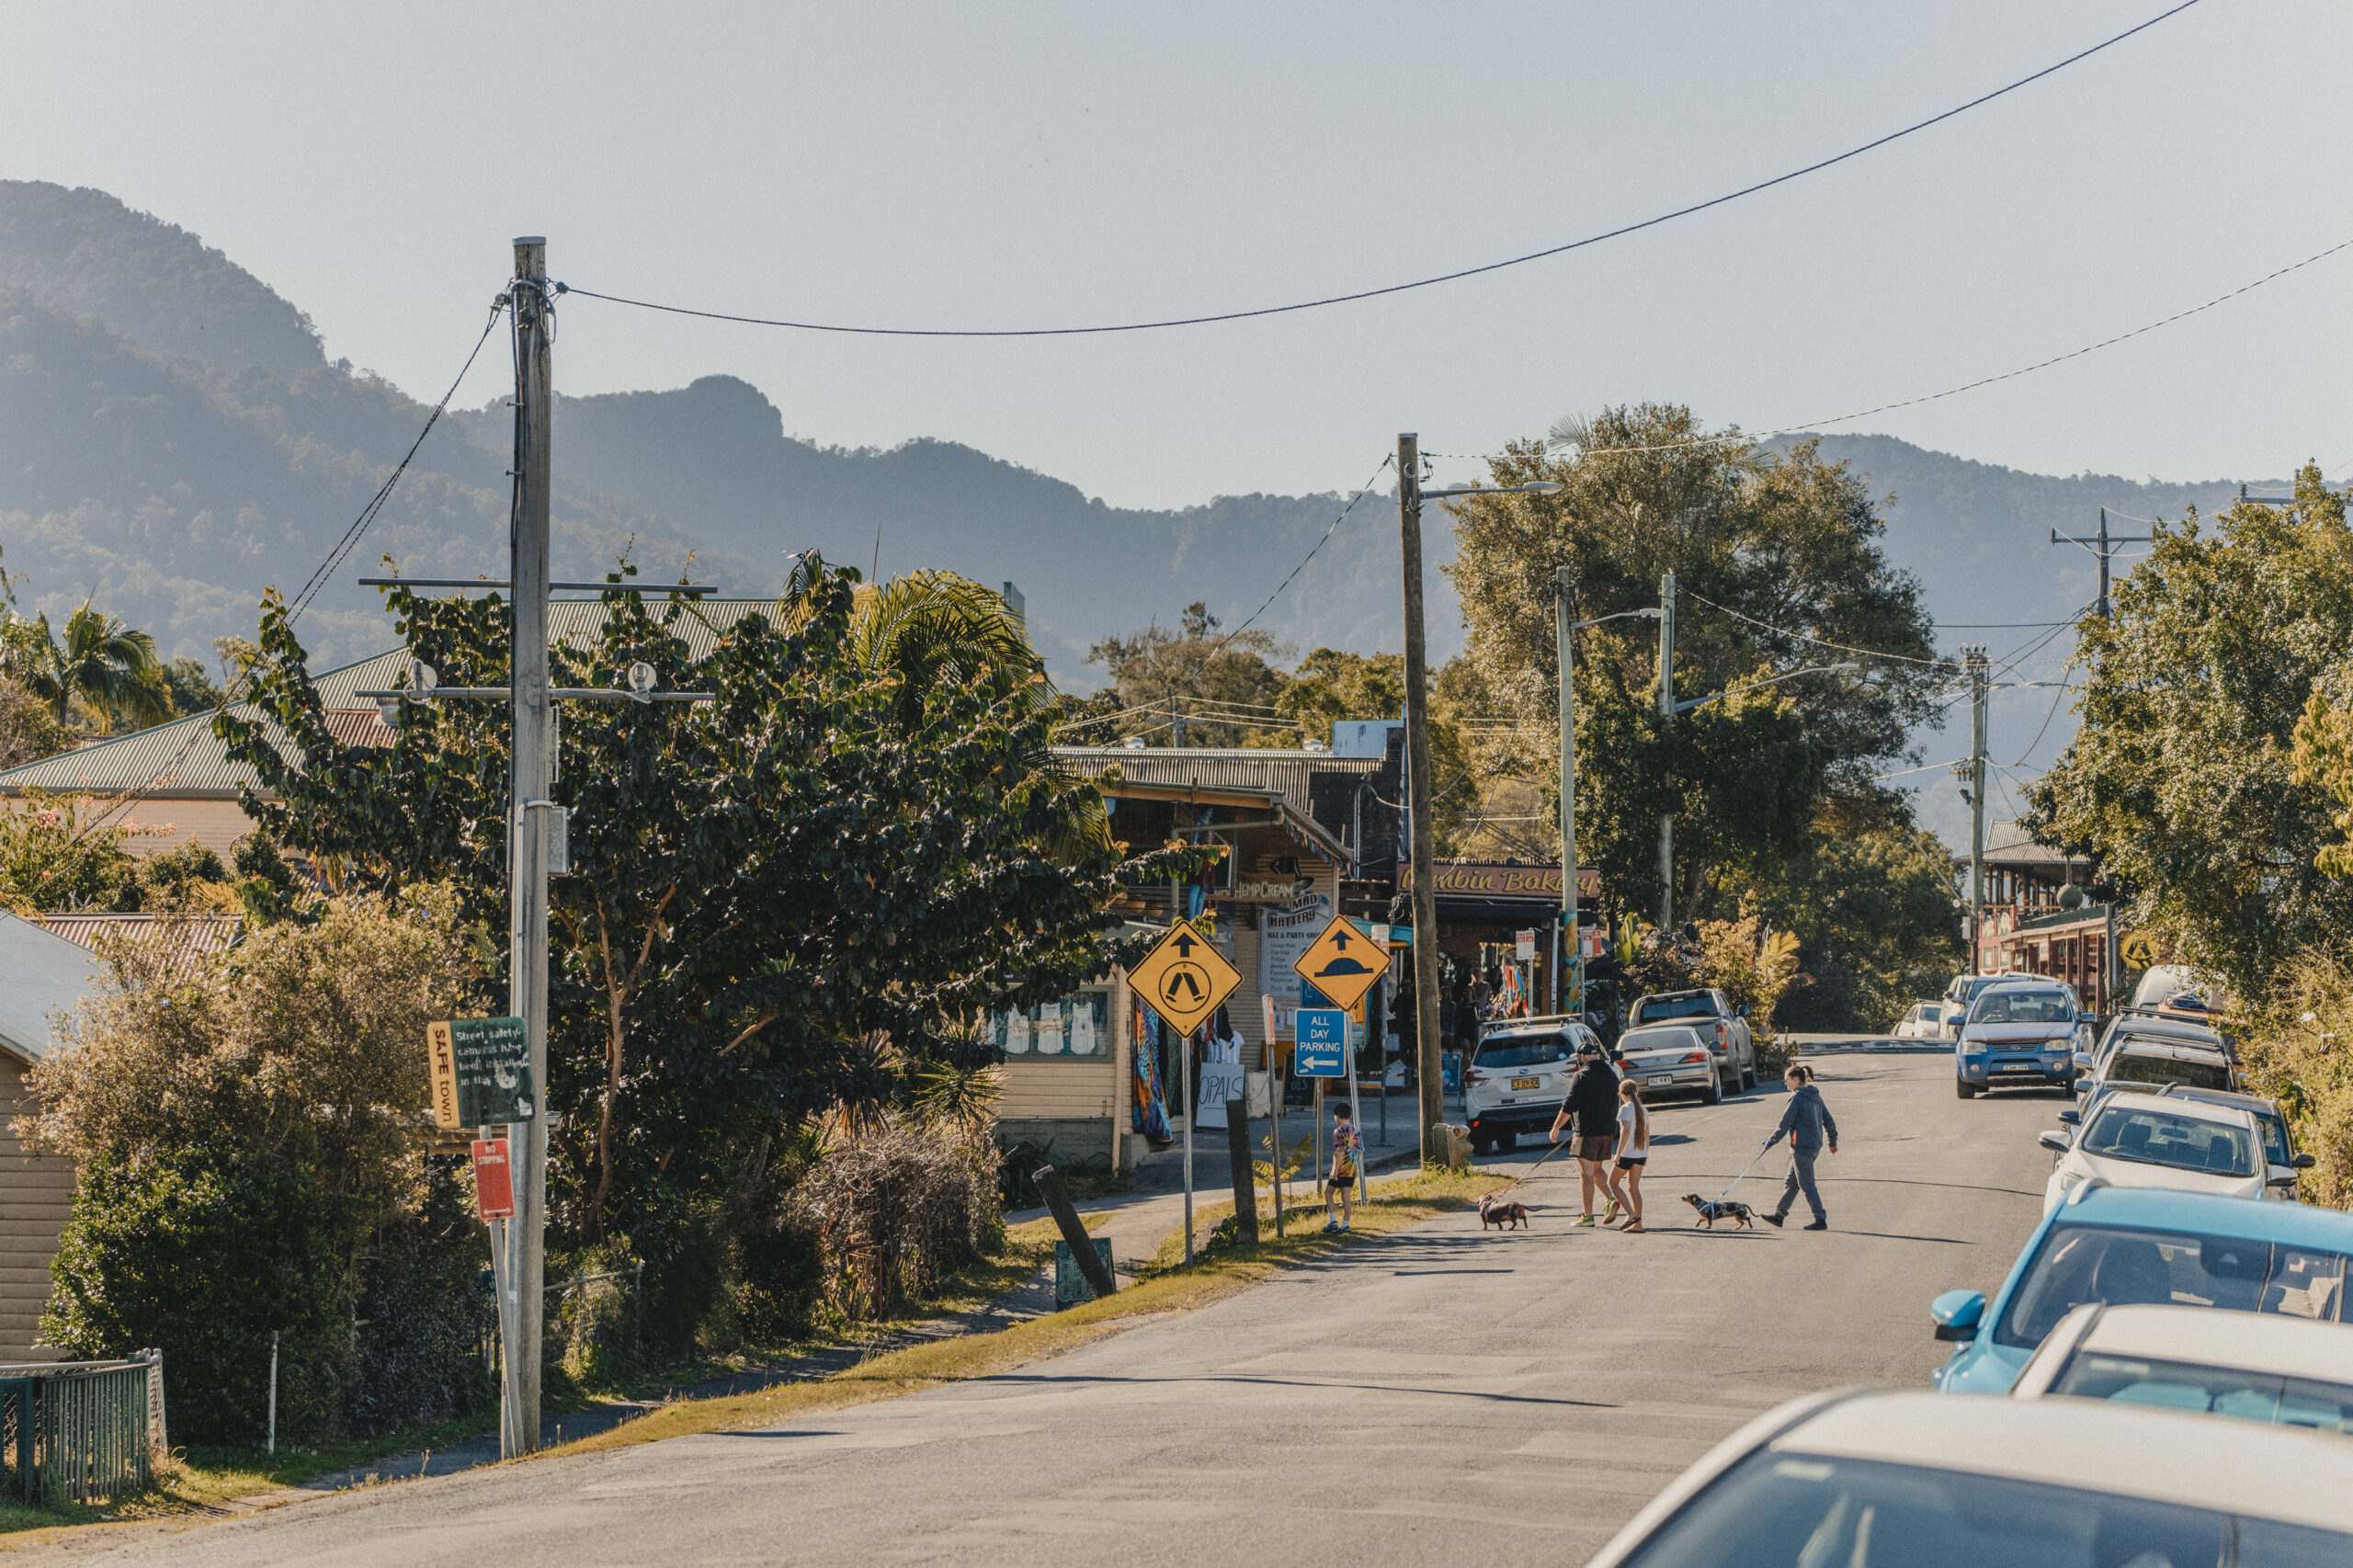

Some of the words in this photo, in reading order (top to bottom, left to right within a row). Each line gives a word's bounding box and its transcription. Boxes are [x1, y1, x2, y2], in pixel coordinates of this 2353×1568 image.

[1401, 869, 1495, 890] mbin
[1500, 870, 1595, 896] Bakey
[1292, 894, 1317, 911] MAD
[1269, 910, 1315, 927] HATTERY
[1267, 931, 1279, 939] HAT
[1286, 931, 1304, 939] PARTY
[1306, 931, 1322, 939] SHO
[1311, 1016, 1330, 1026] ALL
[456, 1029, 485, 1041] Street
[1310, 1028, 1329, 1040] DAY
[435, 1028, 449, 1075] SAFE
[1300, 1041, 1341, 1052] PARKING
[440, 1080, 452, 1122] town
[484, 1144, 496, 1154] NO
[478, 1154, 506, 1165] STOPPING
